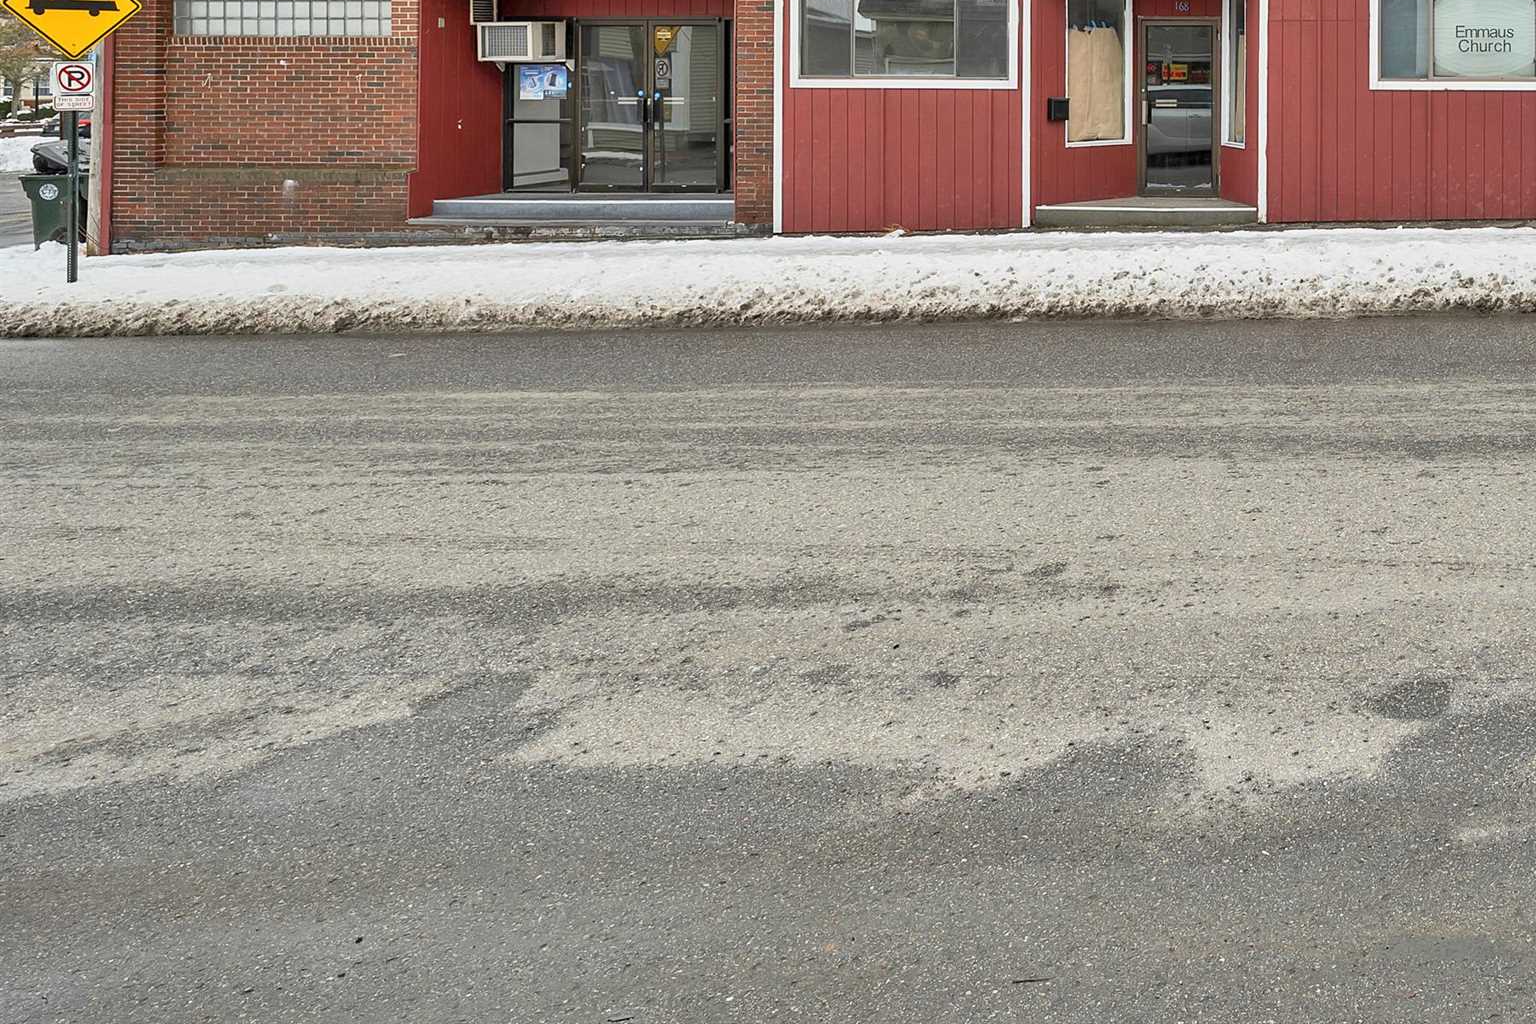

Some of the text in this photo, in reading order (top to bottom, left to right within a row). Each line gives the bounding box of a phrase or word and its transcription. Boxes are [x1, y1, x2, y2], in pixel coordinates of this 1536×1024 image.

[1175, 1, 1190, 12] 168
[1455, 25, 1515, 38] Emmaus
[1458, 39, 1512, 53] Church
